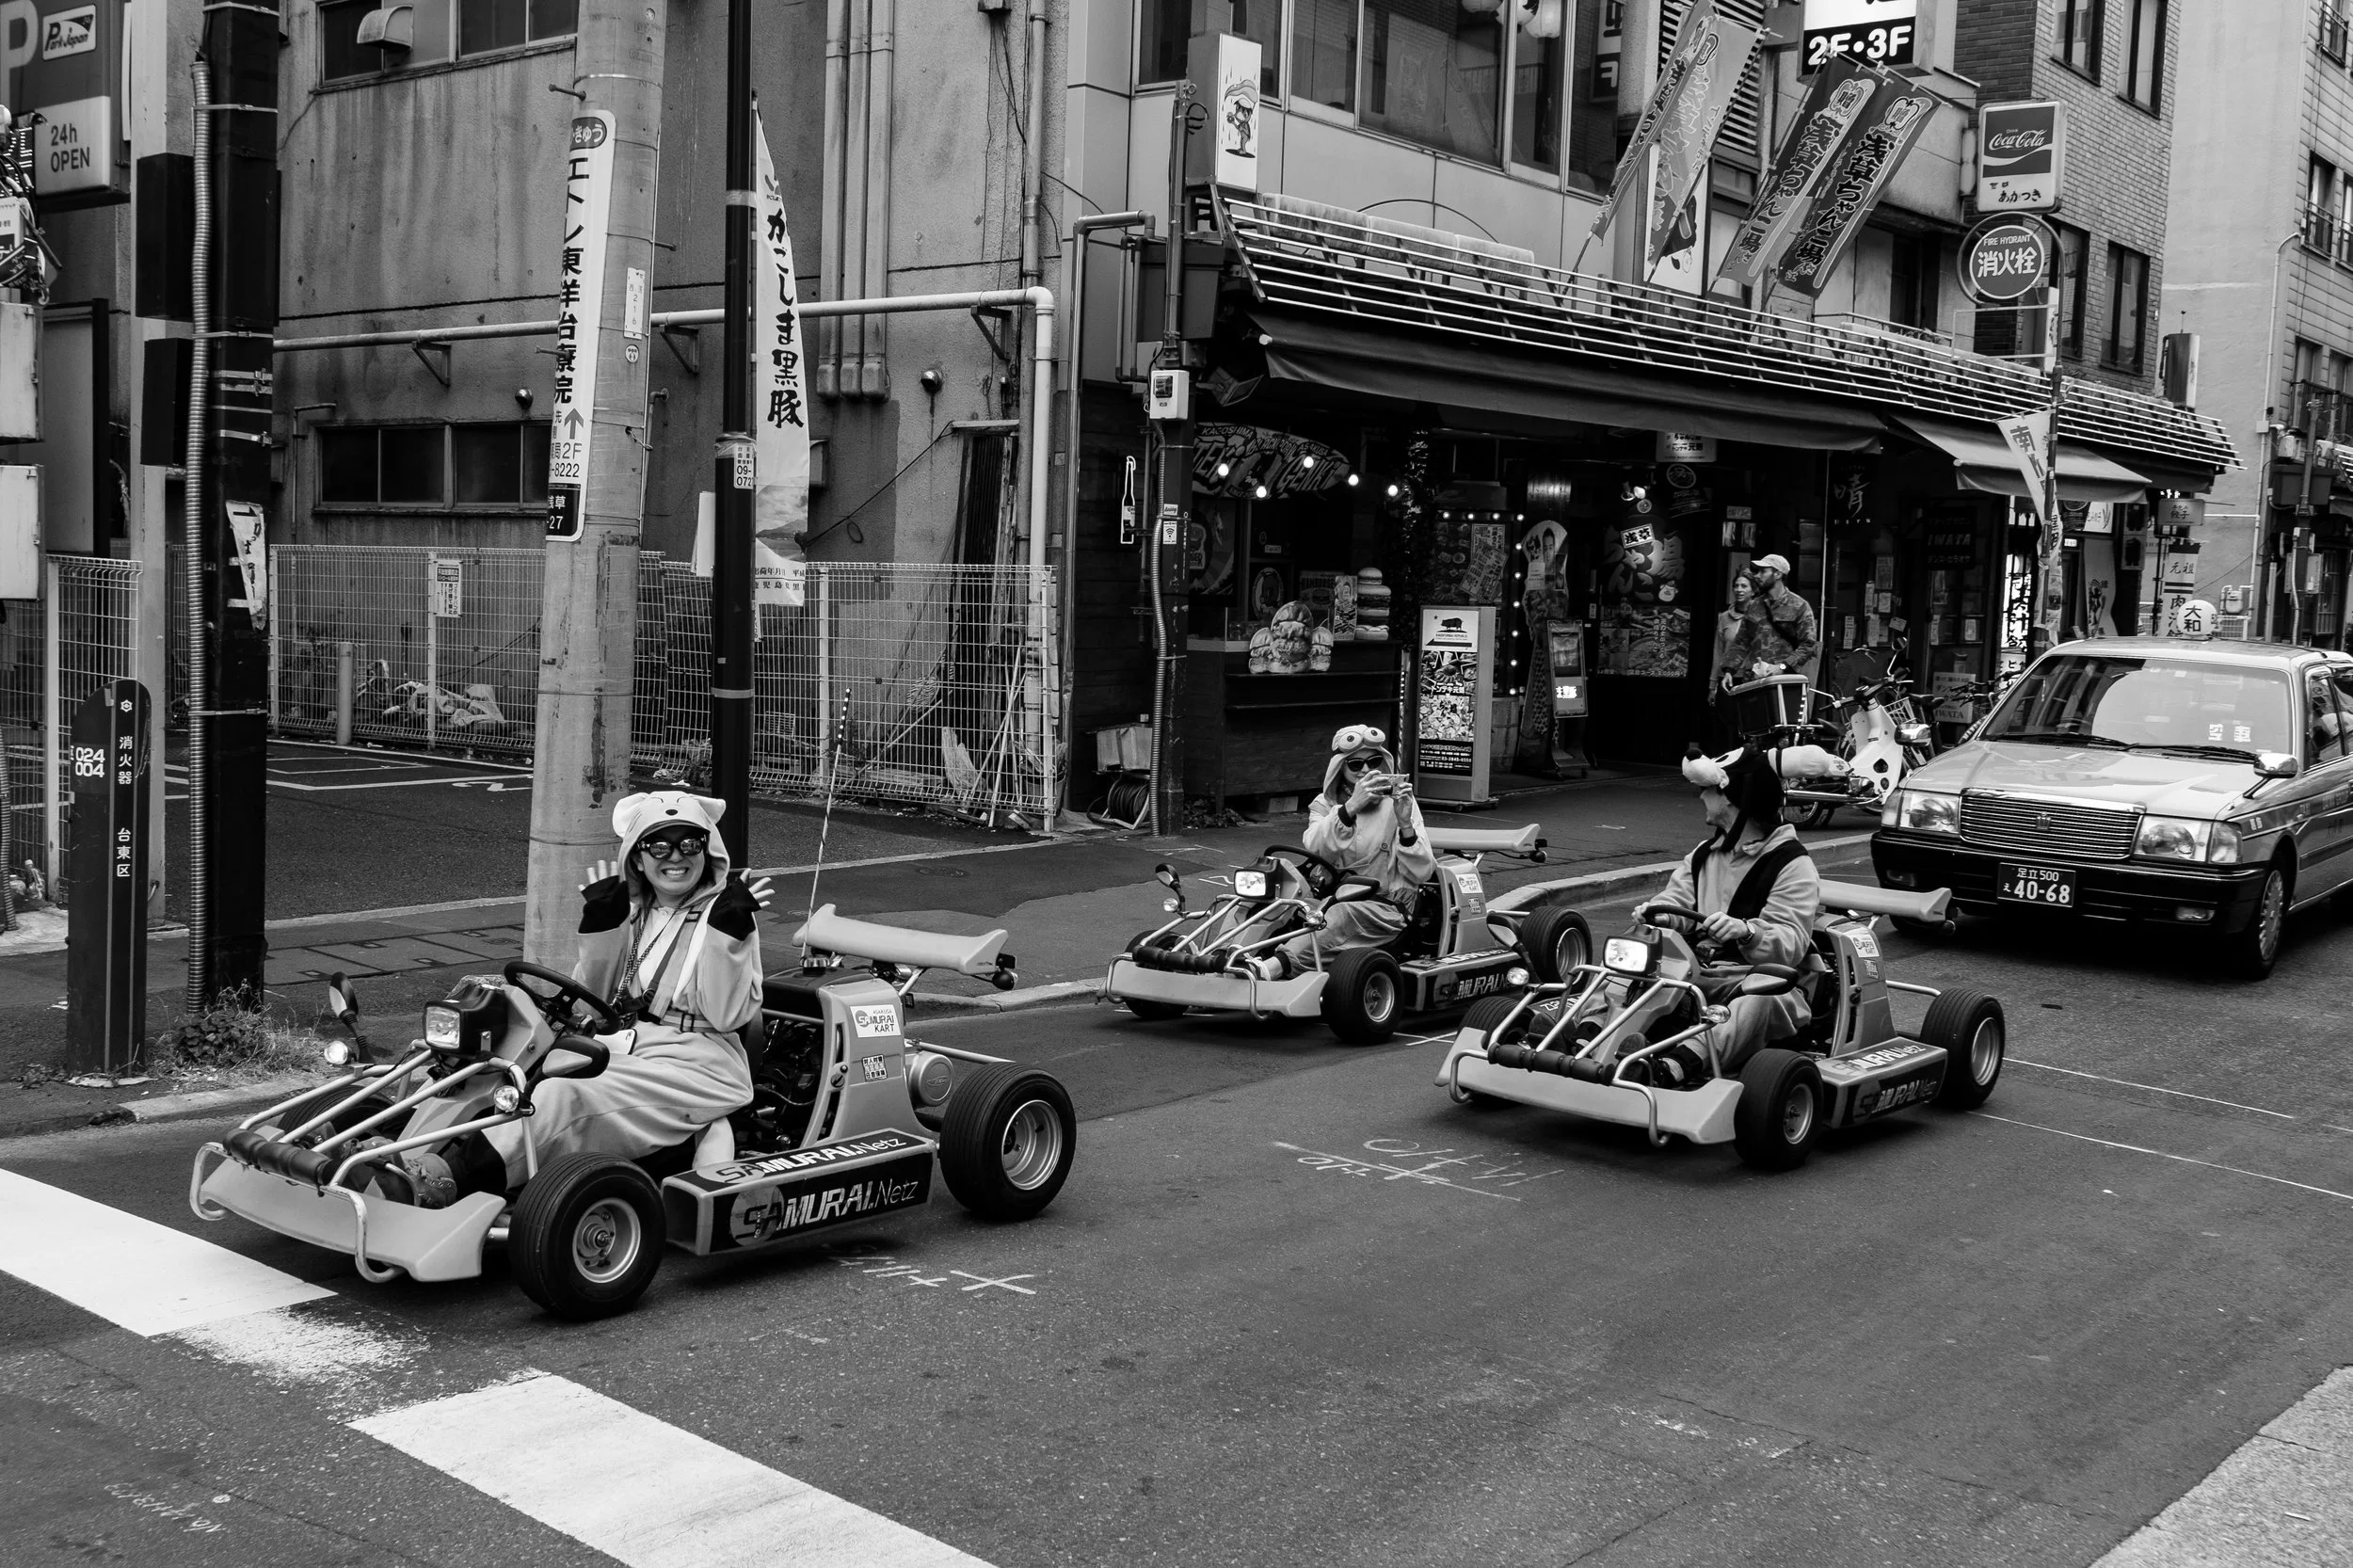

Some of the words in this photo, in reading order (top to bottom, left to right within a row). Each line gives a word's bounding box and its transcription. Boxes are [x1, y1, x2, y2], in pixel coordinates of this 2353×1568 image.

[51, 123, 77, 147] 24h
[1989, 130, 2048, 151] Coca-Cola
[51, 147, 90, 172] OPEN
[1998, 189, 2041, 203] あかつき
[1983, 237, 1998, 246] FIRE
[2000, 234, 2031, 245] HYDRANT
[1977, 247, 2038, 278] 消火栓
[1201, 425, 1255, 439] KAGOSHIMA
[1298, 442, 1331, 457] ASAKUSA
[2170, 562, 2194, 574] 元祖
[2184, 605, 2201, 633] 大和
[118, 735, 133, 785] 消火器
[74, 762, 104, 777] 004
[116, 827, 131, 877] 台東区
[2014, 879, 2071, 904] 40-68
[858, 1015, 895, 1025] SAMURAI
[874, 1024, 895, 1032] KART
